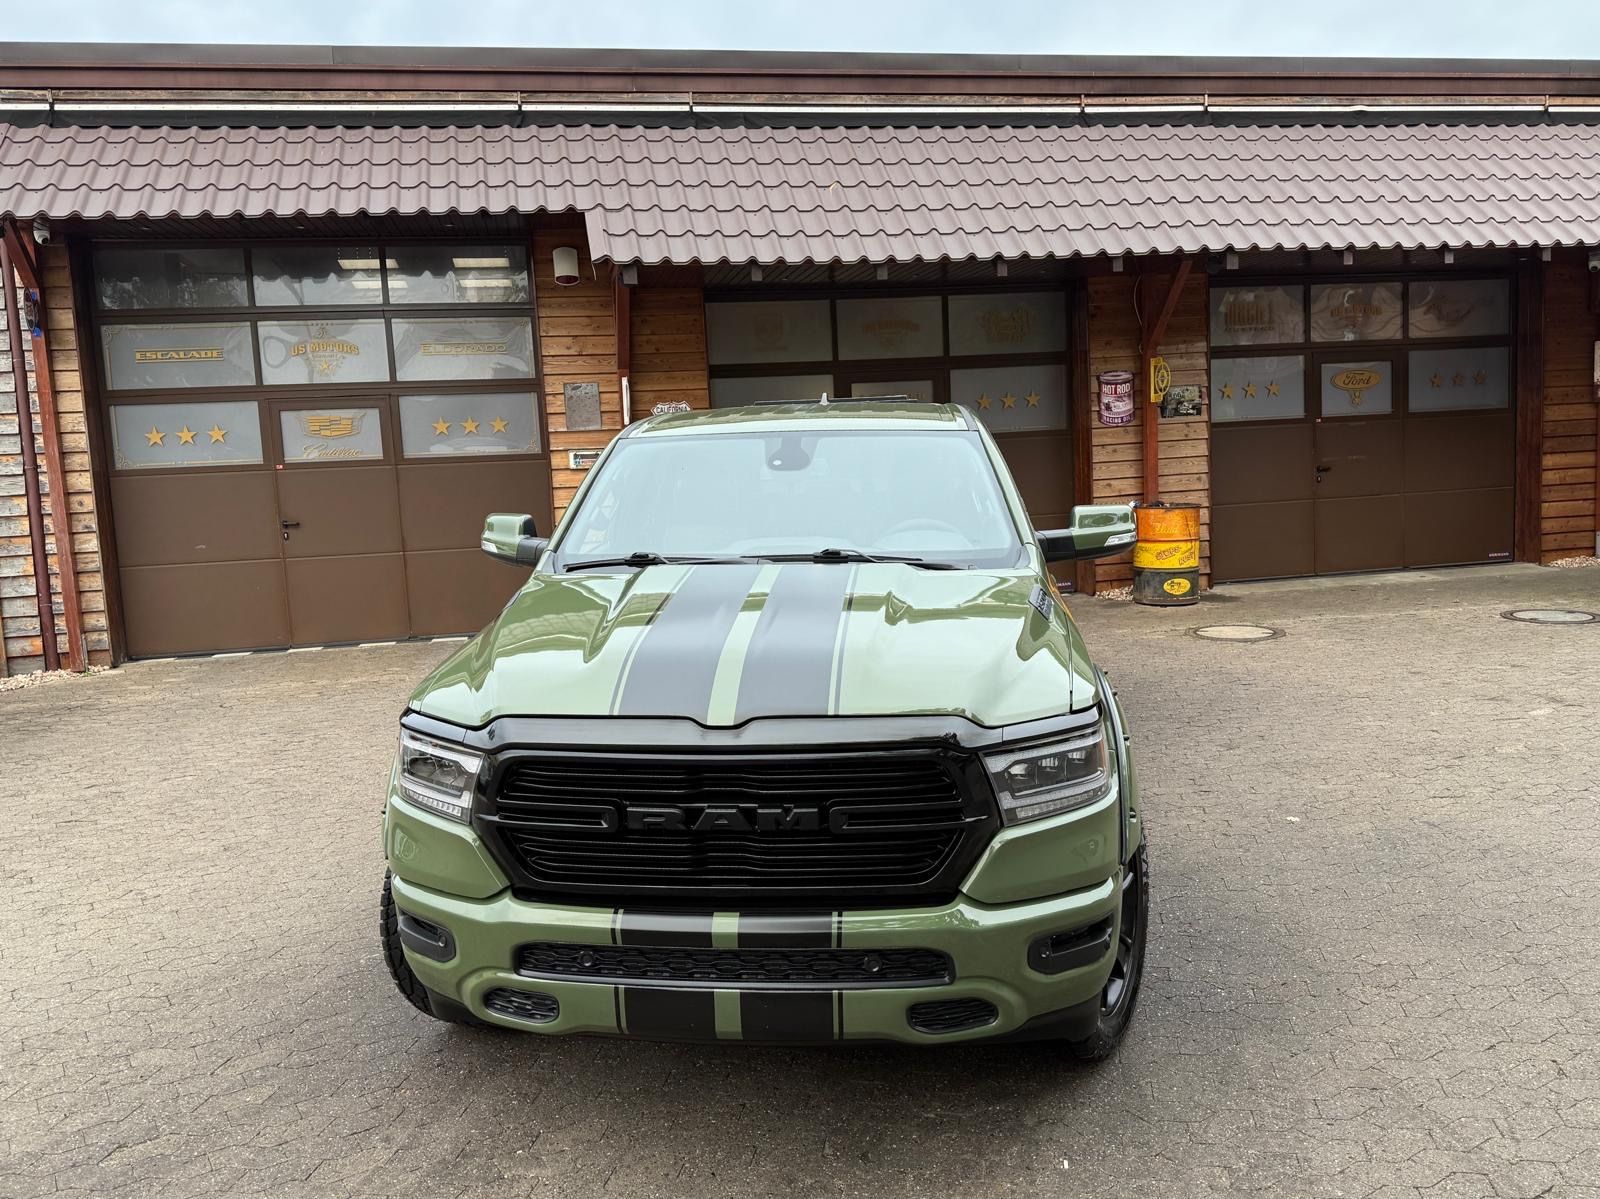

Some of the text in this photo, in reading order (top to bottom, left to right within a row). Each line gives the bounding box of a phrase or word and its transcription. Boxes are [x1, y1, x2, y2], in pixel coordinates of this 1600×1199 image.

[135, 349, 224, 360] ESCALADE
[291, 344, 306, 357] US
[310, 341, 360, 356] MOTORS
[1342, 373, 1372, 386] Ford
[1102, 383, 1131, 395] HOT ROD
[626, 806, 820, 832] RAM
